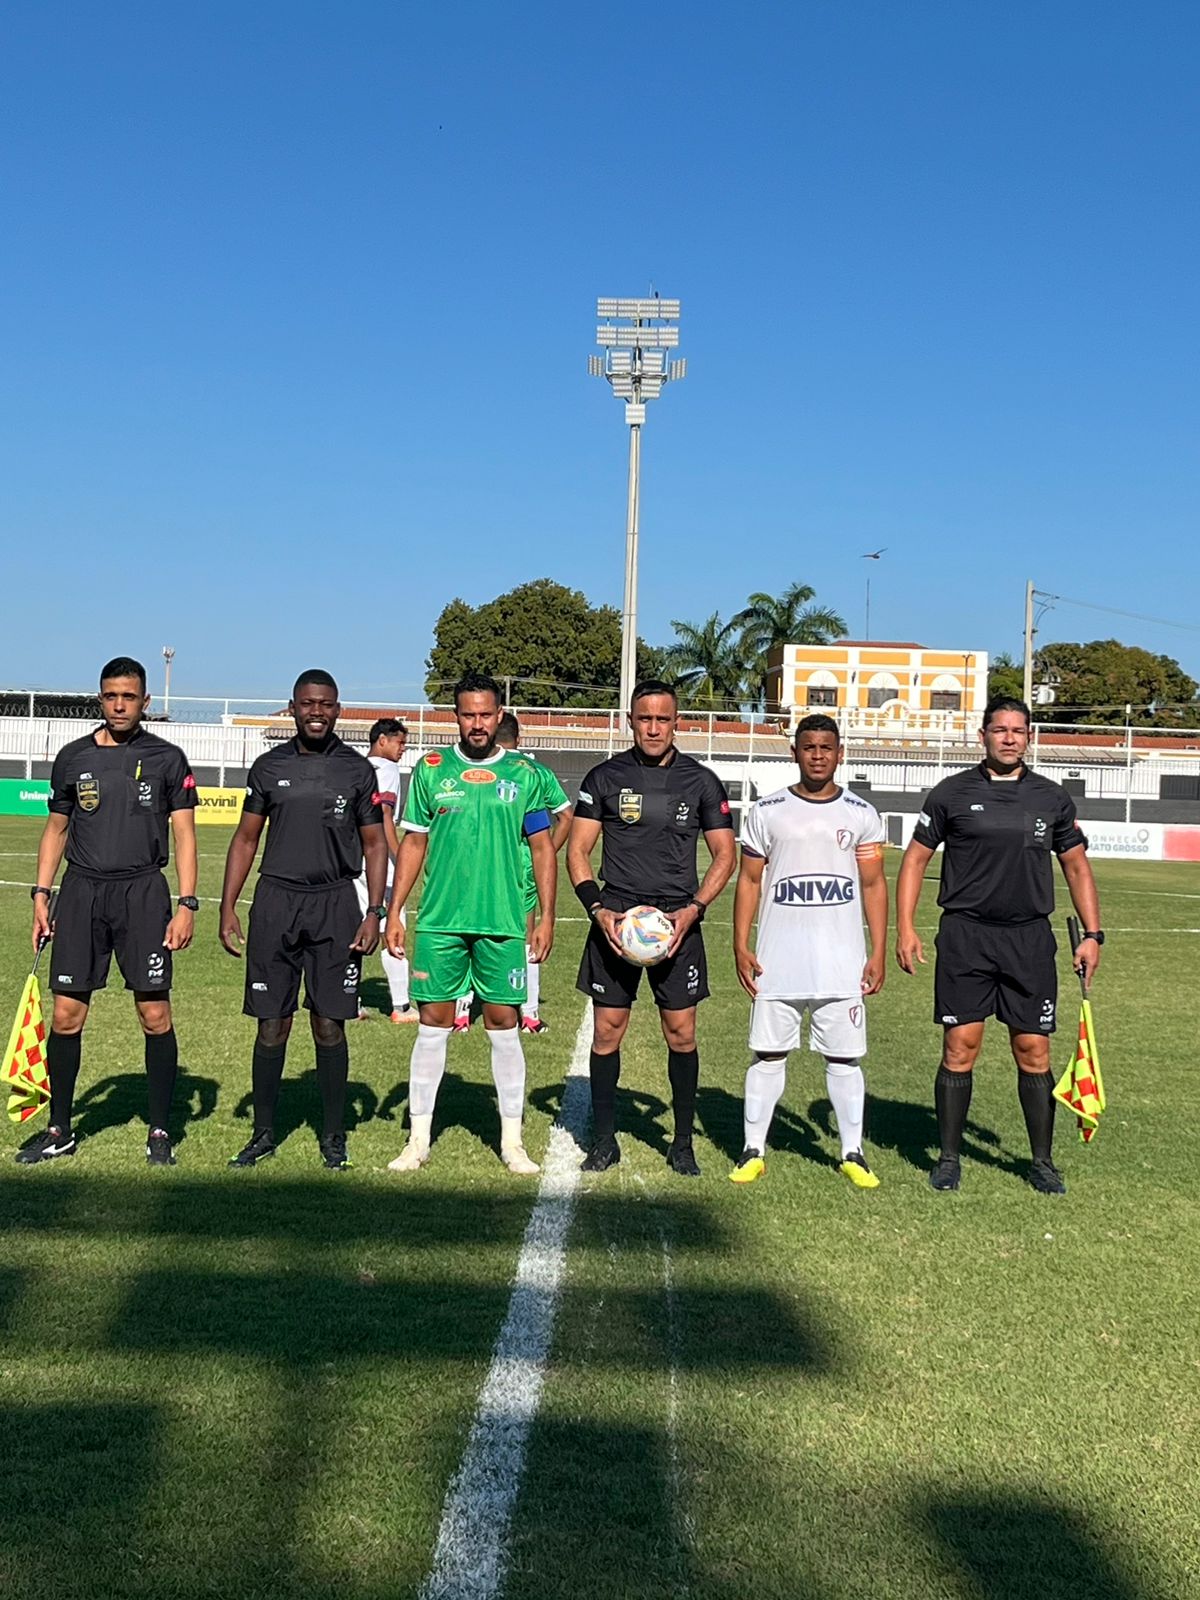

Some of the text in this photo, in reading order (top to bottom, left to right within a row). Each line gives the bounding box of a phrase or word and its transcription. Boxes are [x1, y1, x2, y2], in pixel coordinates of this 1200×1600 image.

[197, 795, 237, 807] axvinil
[1086, 834, 1137, 845] ONHEÇA
[1112, 844, 1149, 853] GROSSO
[772, 878, 855, 904] UNIVAG
